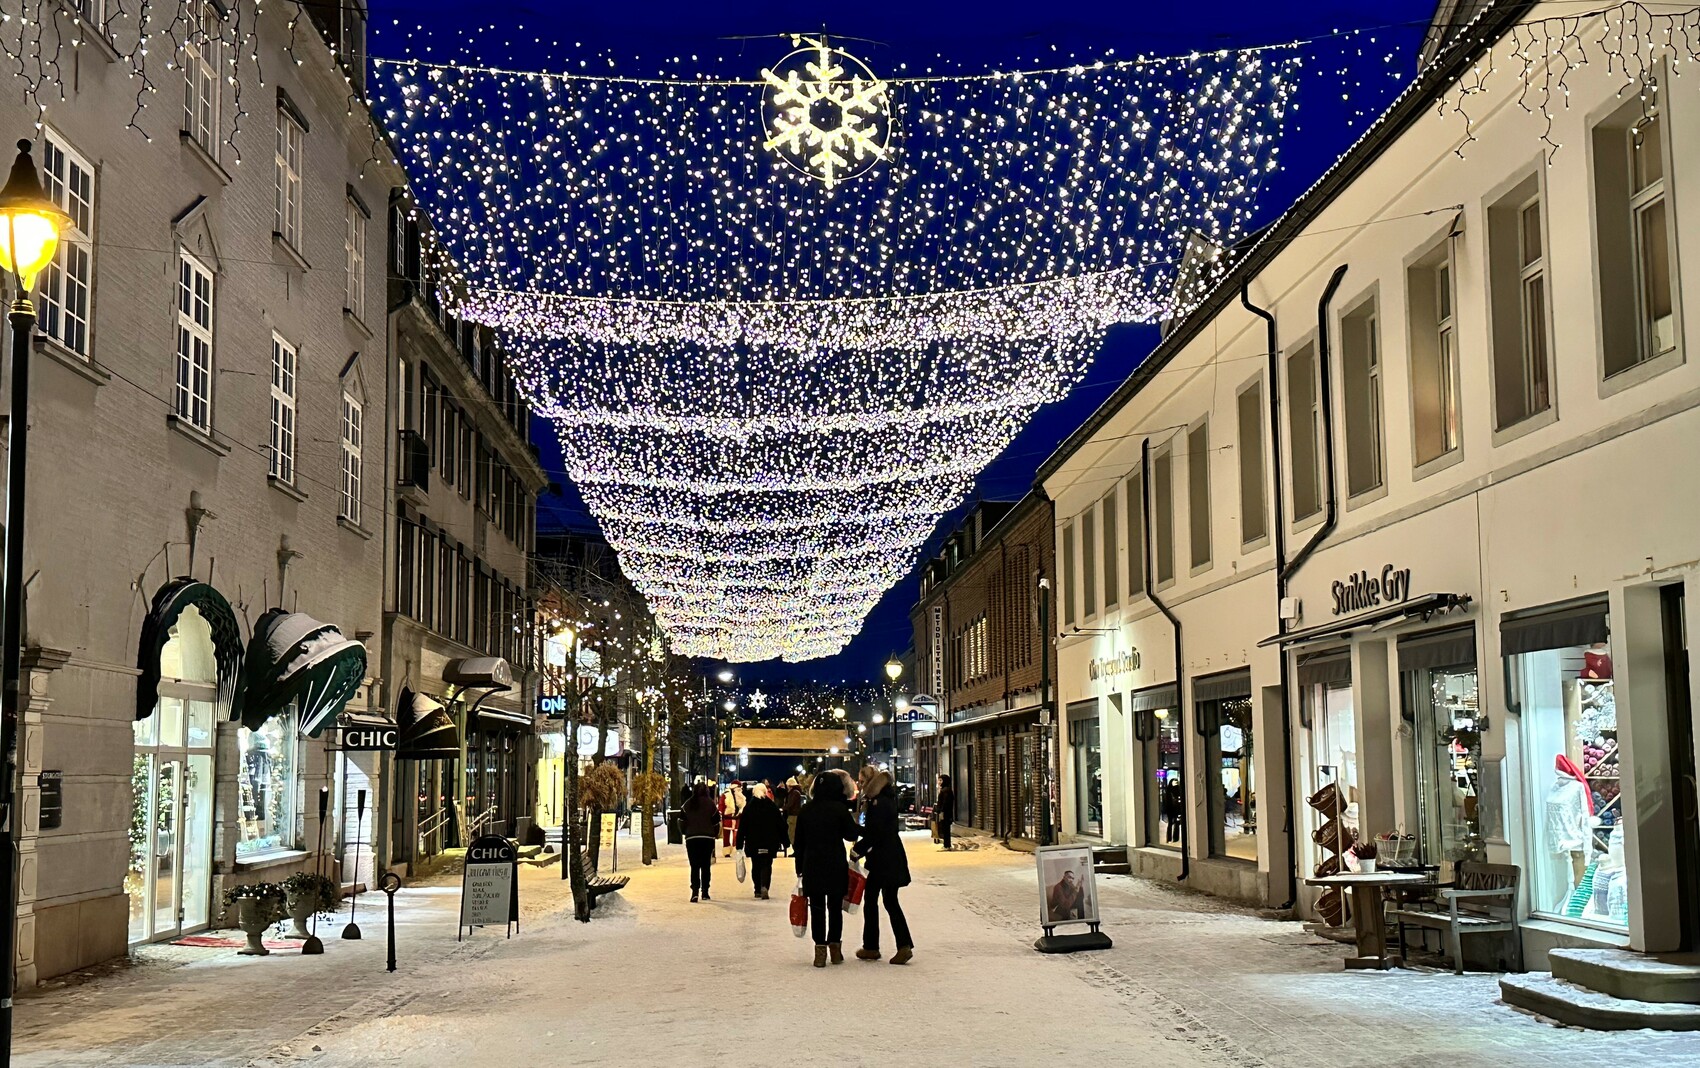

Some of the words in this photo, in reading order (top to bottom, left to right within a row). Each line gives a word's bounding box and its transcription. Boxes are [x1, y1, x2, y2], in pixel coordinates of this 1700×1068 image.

[1331, 570, 1380, 615] Strikke
[1381, 563, 1410, 602] Gry
[896, 709, 933, 721] RCADEN
[345, 730, 397, 747] CHIC
[471, 847, 509, 859] CHIC
